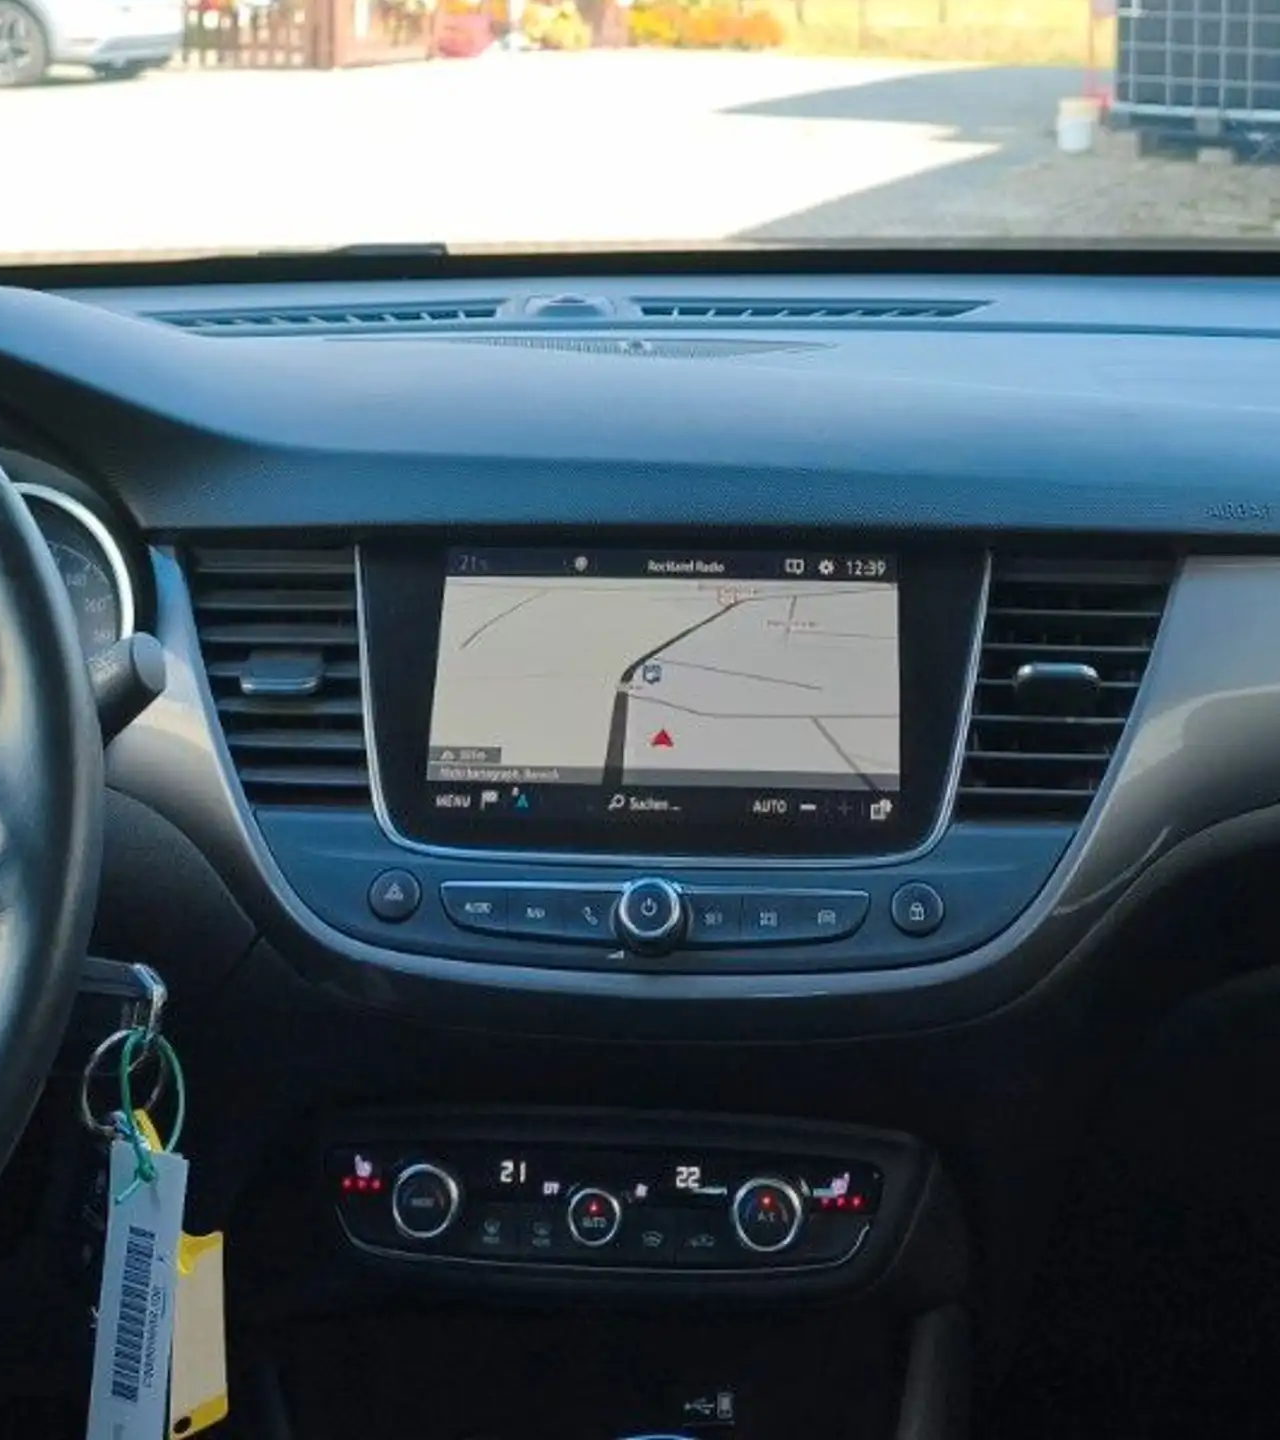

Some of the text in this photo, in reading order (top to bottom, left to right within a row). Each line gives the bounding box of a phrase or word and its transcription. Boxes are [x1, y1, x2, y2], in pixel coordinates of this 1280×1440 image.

[696, 561, 725, 574] Radio
[845, 560, 887, 576] 12:39
[435, 793, 472, 808] MENU
[752, 799, 788, 813] AUTO
[499, 1159, 527, 1183] 21
[675, 1165, 702, 1189] 22
